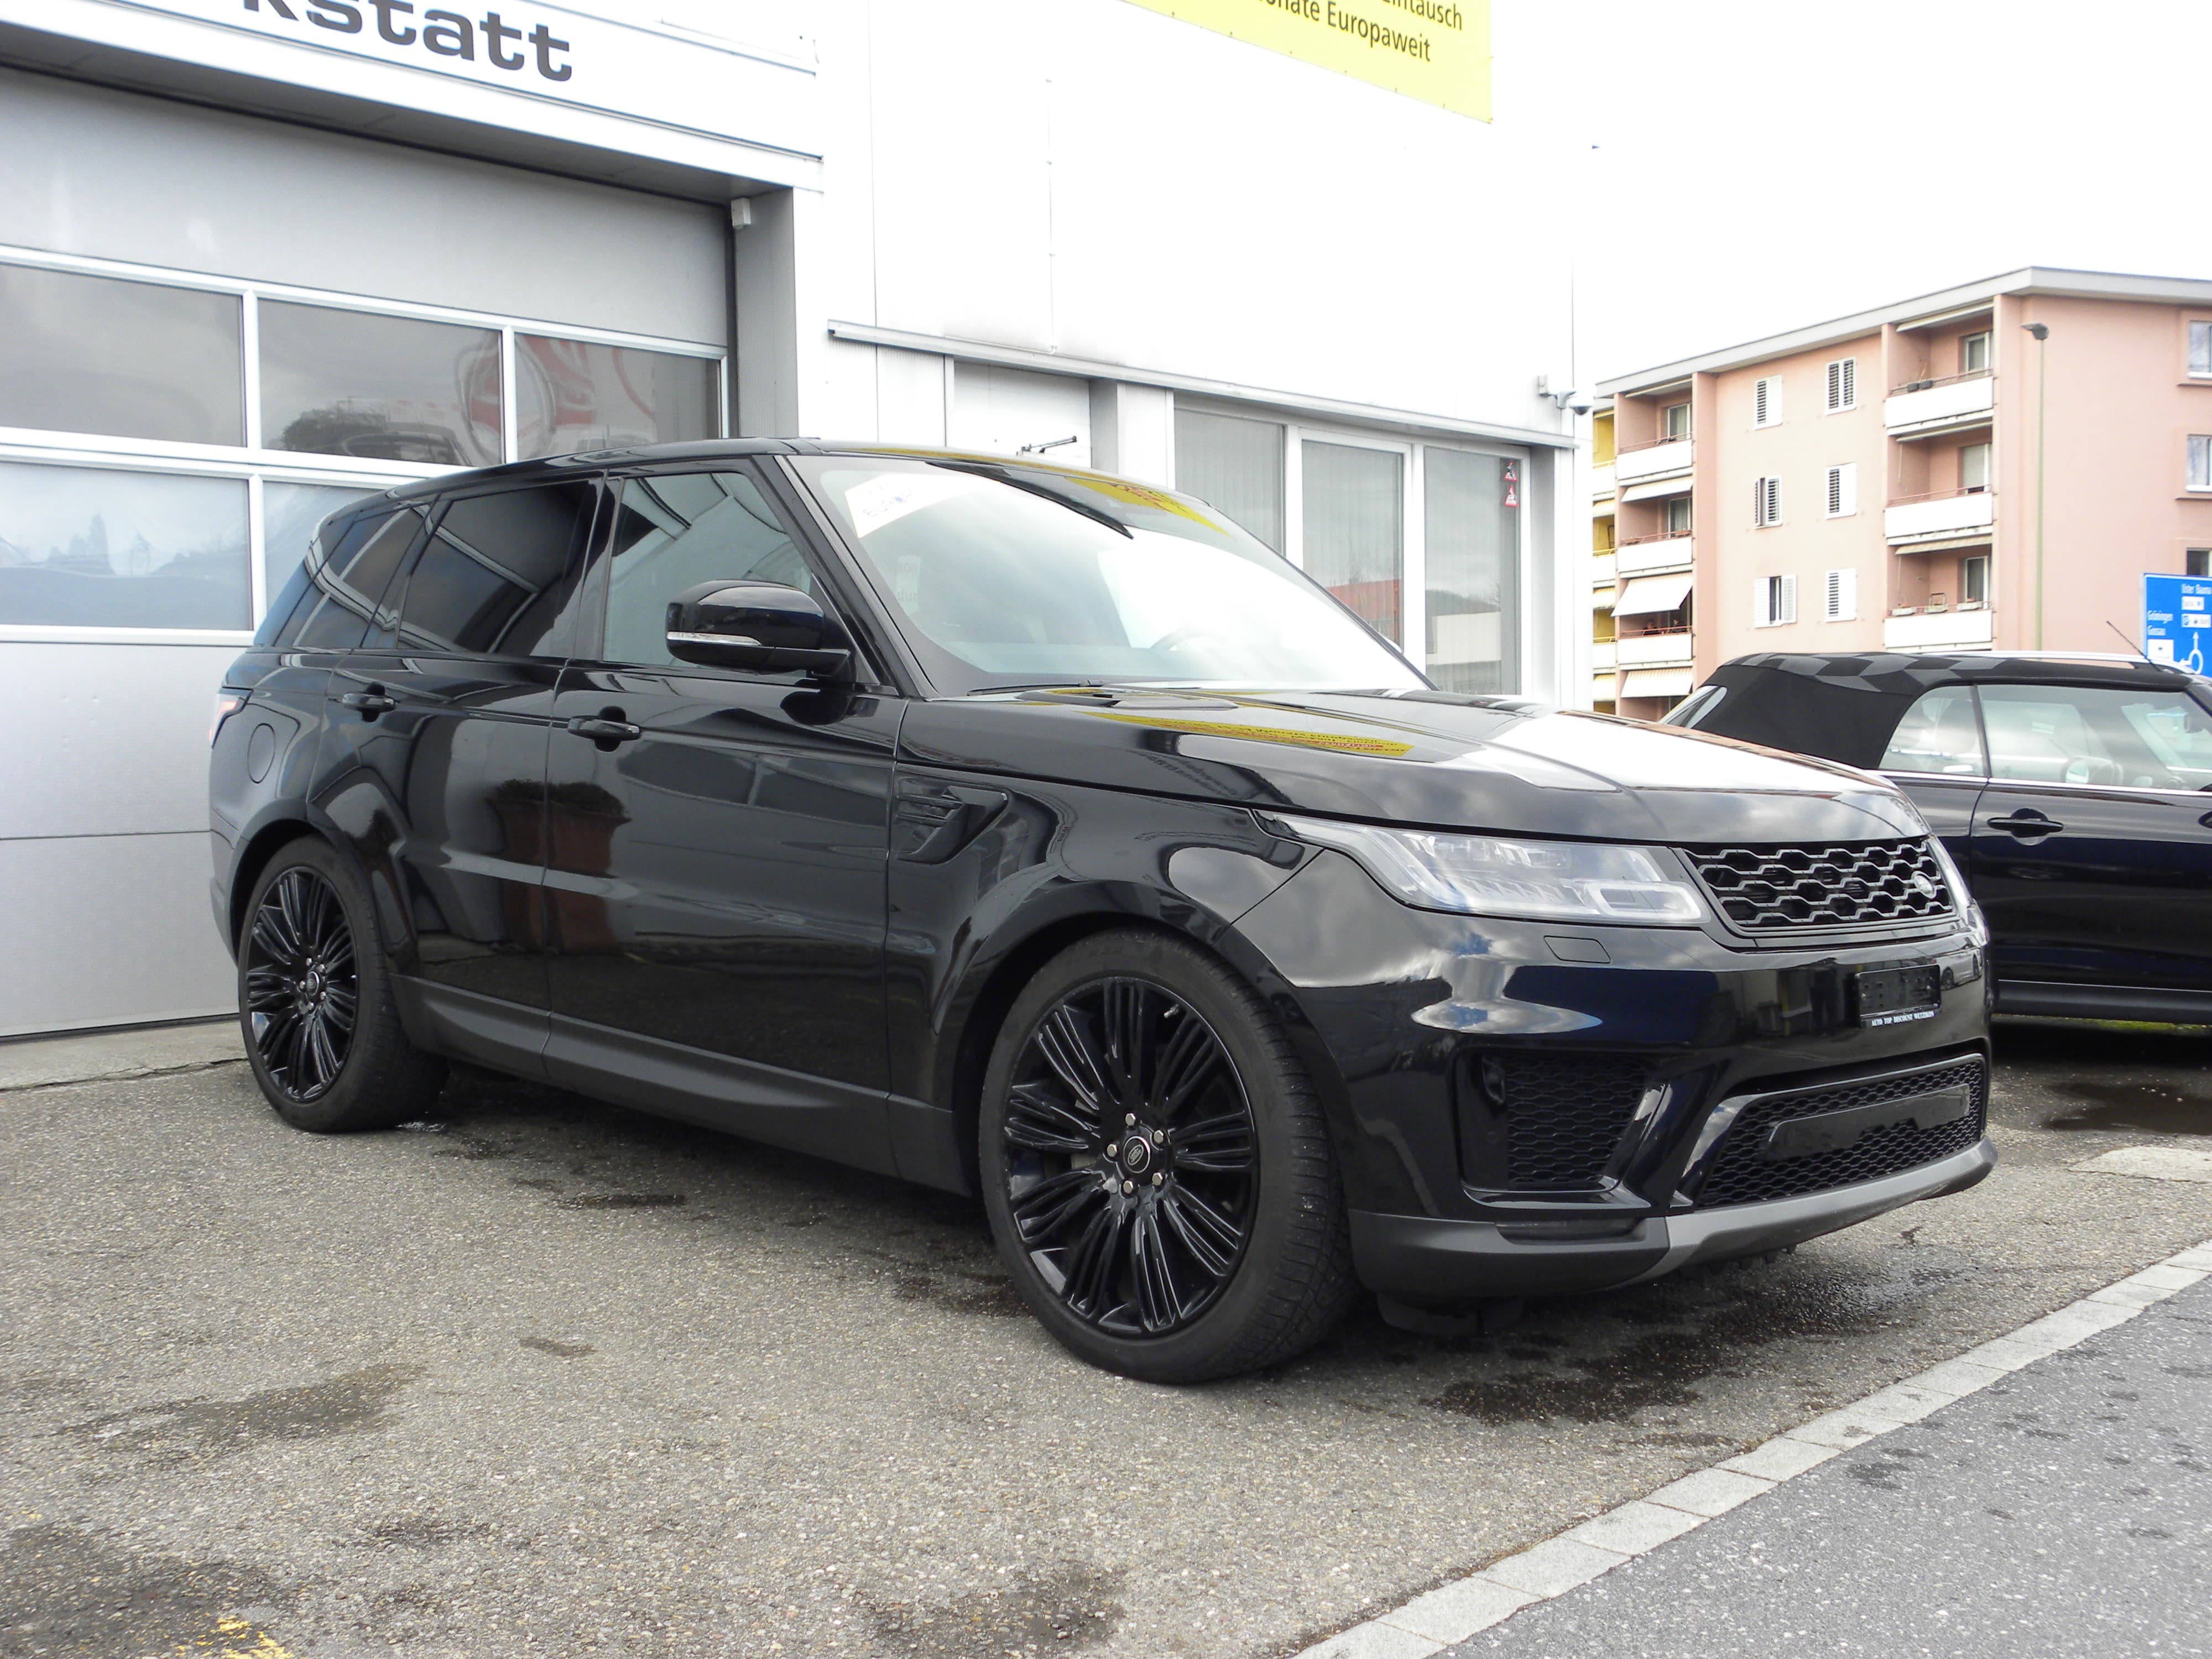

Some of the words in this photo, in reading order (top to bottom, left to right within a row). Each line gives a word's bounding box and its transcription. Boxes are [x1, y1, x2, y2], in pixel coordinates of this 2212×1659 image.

[244, 0, 572, 82] statt
[1327, 1, 1431, 62] Europaweit
[1871, 1019, 1883, 1027] AUTO
[1893, 1014, 1913, 1023] DISCOUNT
